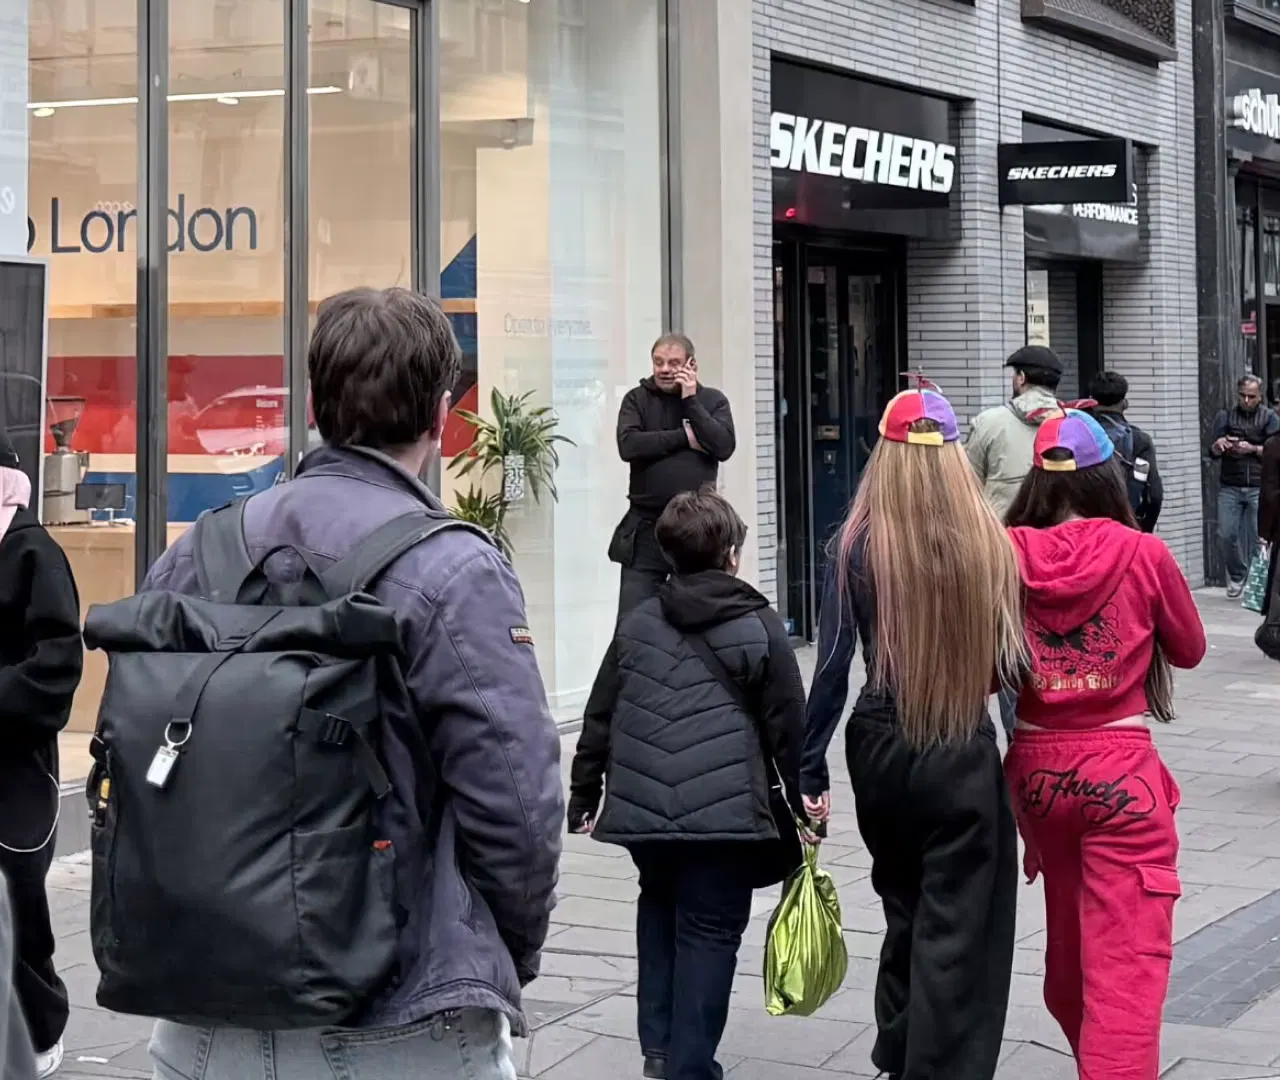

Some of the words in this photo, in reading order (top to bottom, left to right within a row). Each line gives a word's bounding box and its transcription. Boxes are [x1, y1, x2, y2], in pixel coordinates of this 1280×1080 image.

[770, 111, 955, 193] SKECHERS
[1007, 163, 1117, 180] SKECHERS
[1072, 203, 1138, 225] PERFORMANCE
